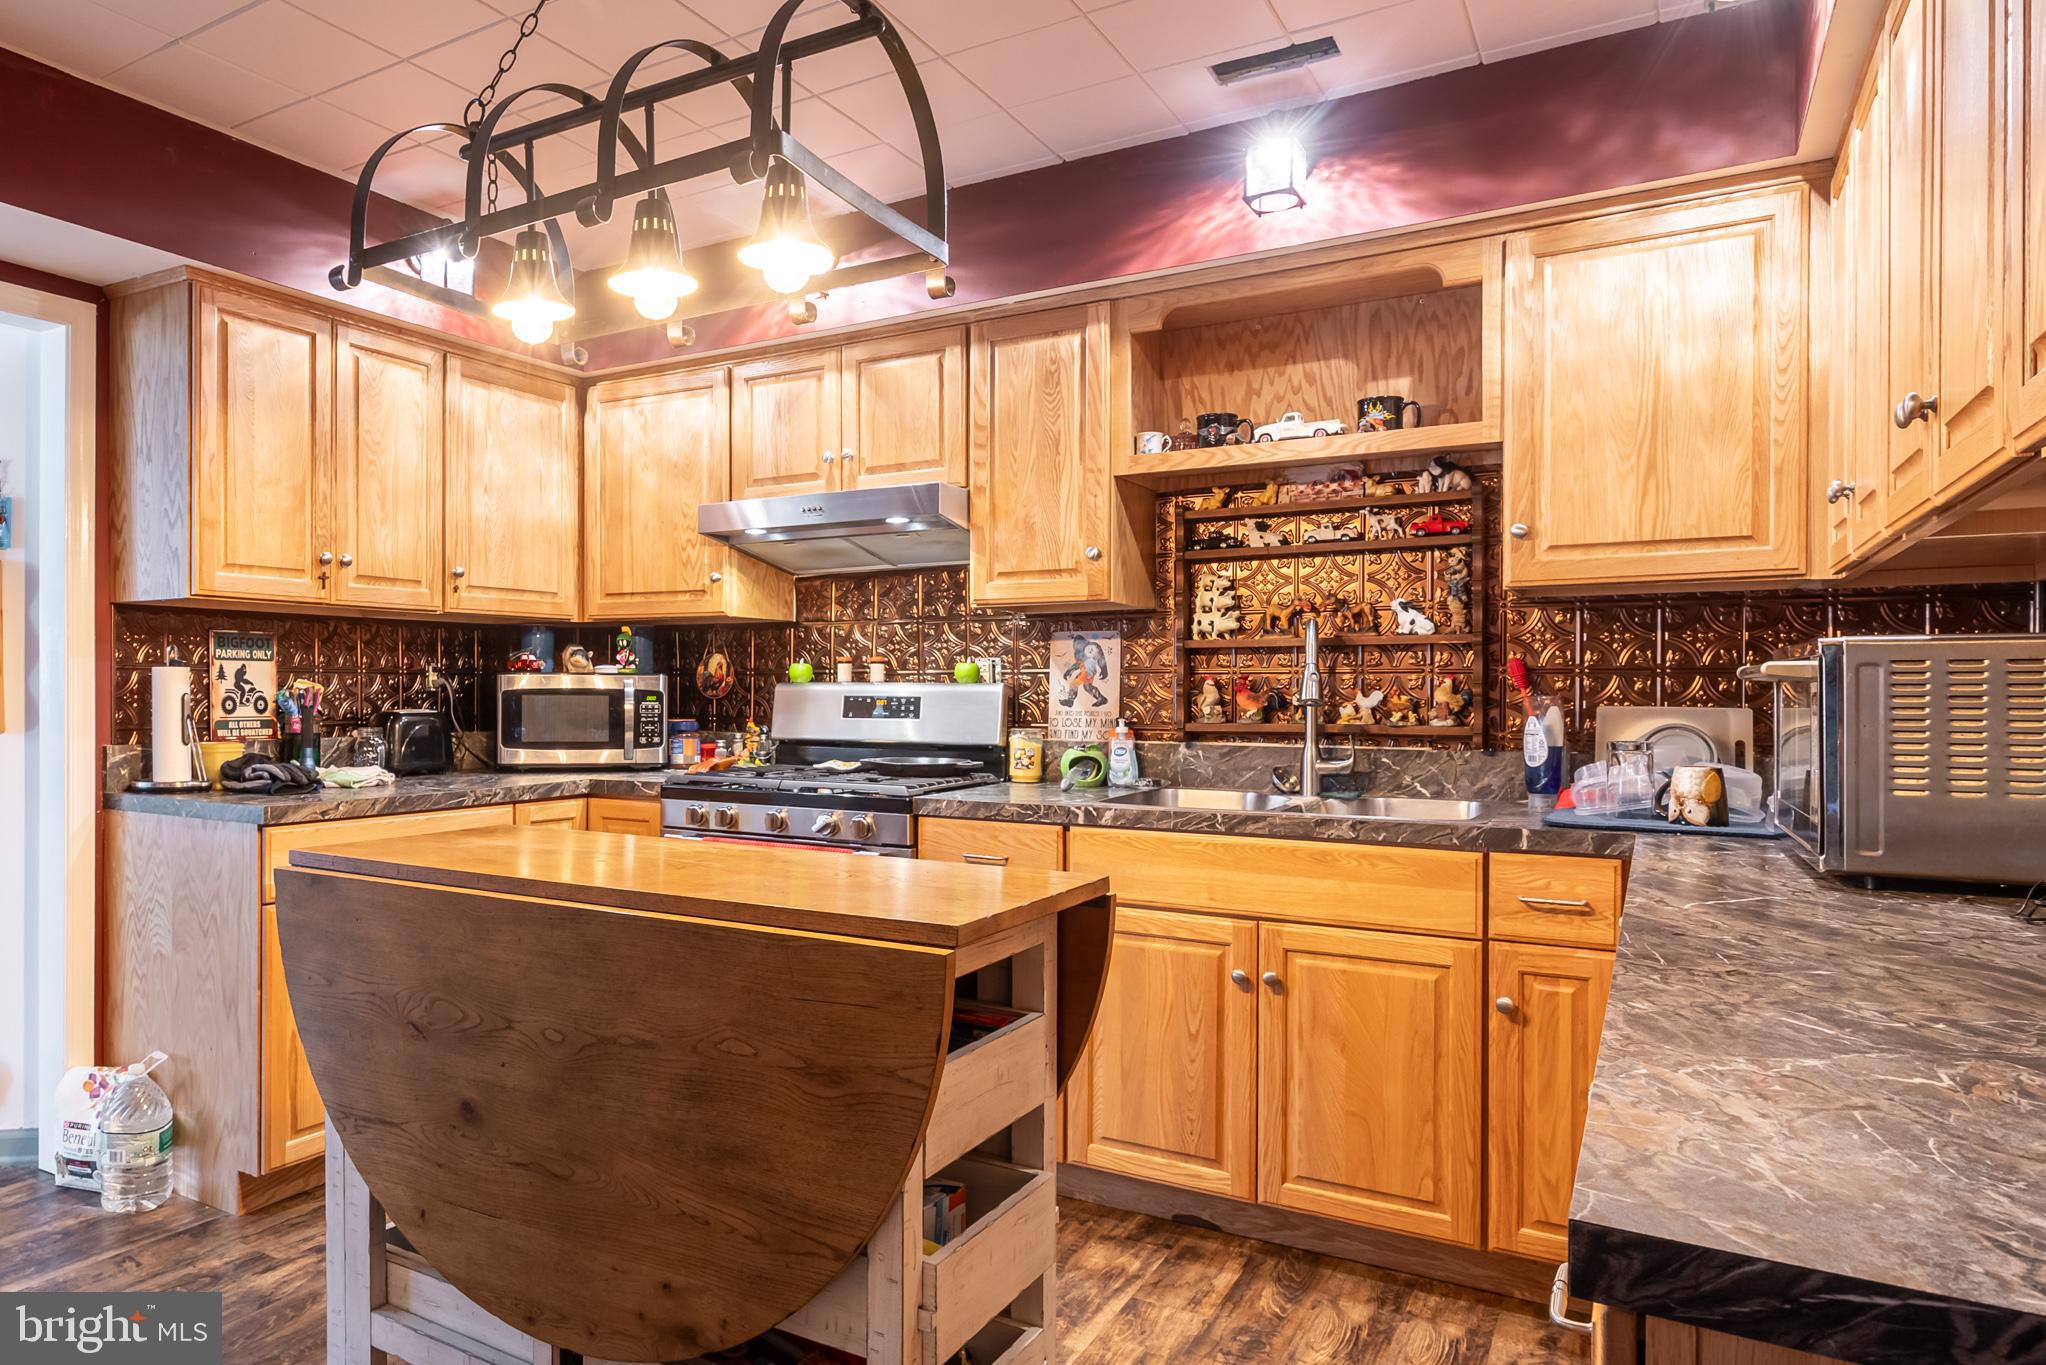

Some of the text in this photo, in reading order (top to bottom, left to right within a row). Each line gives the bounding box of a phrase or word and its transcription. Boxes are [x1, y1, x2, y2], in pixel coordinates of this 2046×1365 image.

[217, 635, 272, 649] BIGFOOT
[215, 649, 272, 660] PARKING ONLY
[228, 720, 261, 729] ALL OTHERS
[1048, 718, 1059, 728] TO
[1061, 718, 1082, 728] LOSE
[1085, 718, 1097, 728] MY
[216, 729, 231, 737] WILL
[232, 729, 240, 737] BE
[1050, 729, 1062, 739] AND
[1064, 729, 1079, 739] FIND
[1081, 729, 1093, 740] MY
